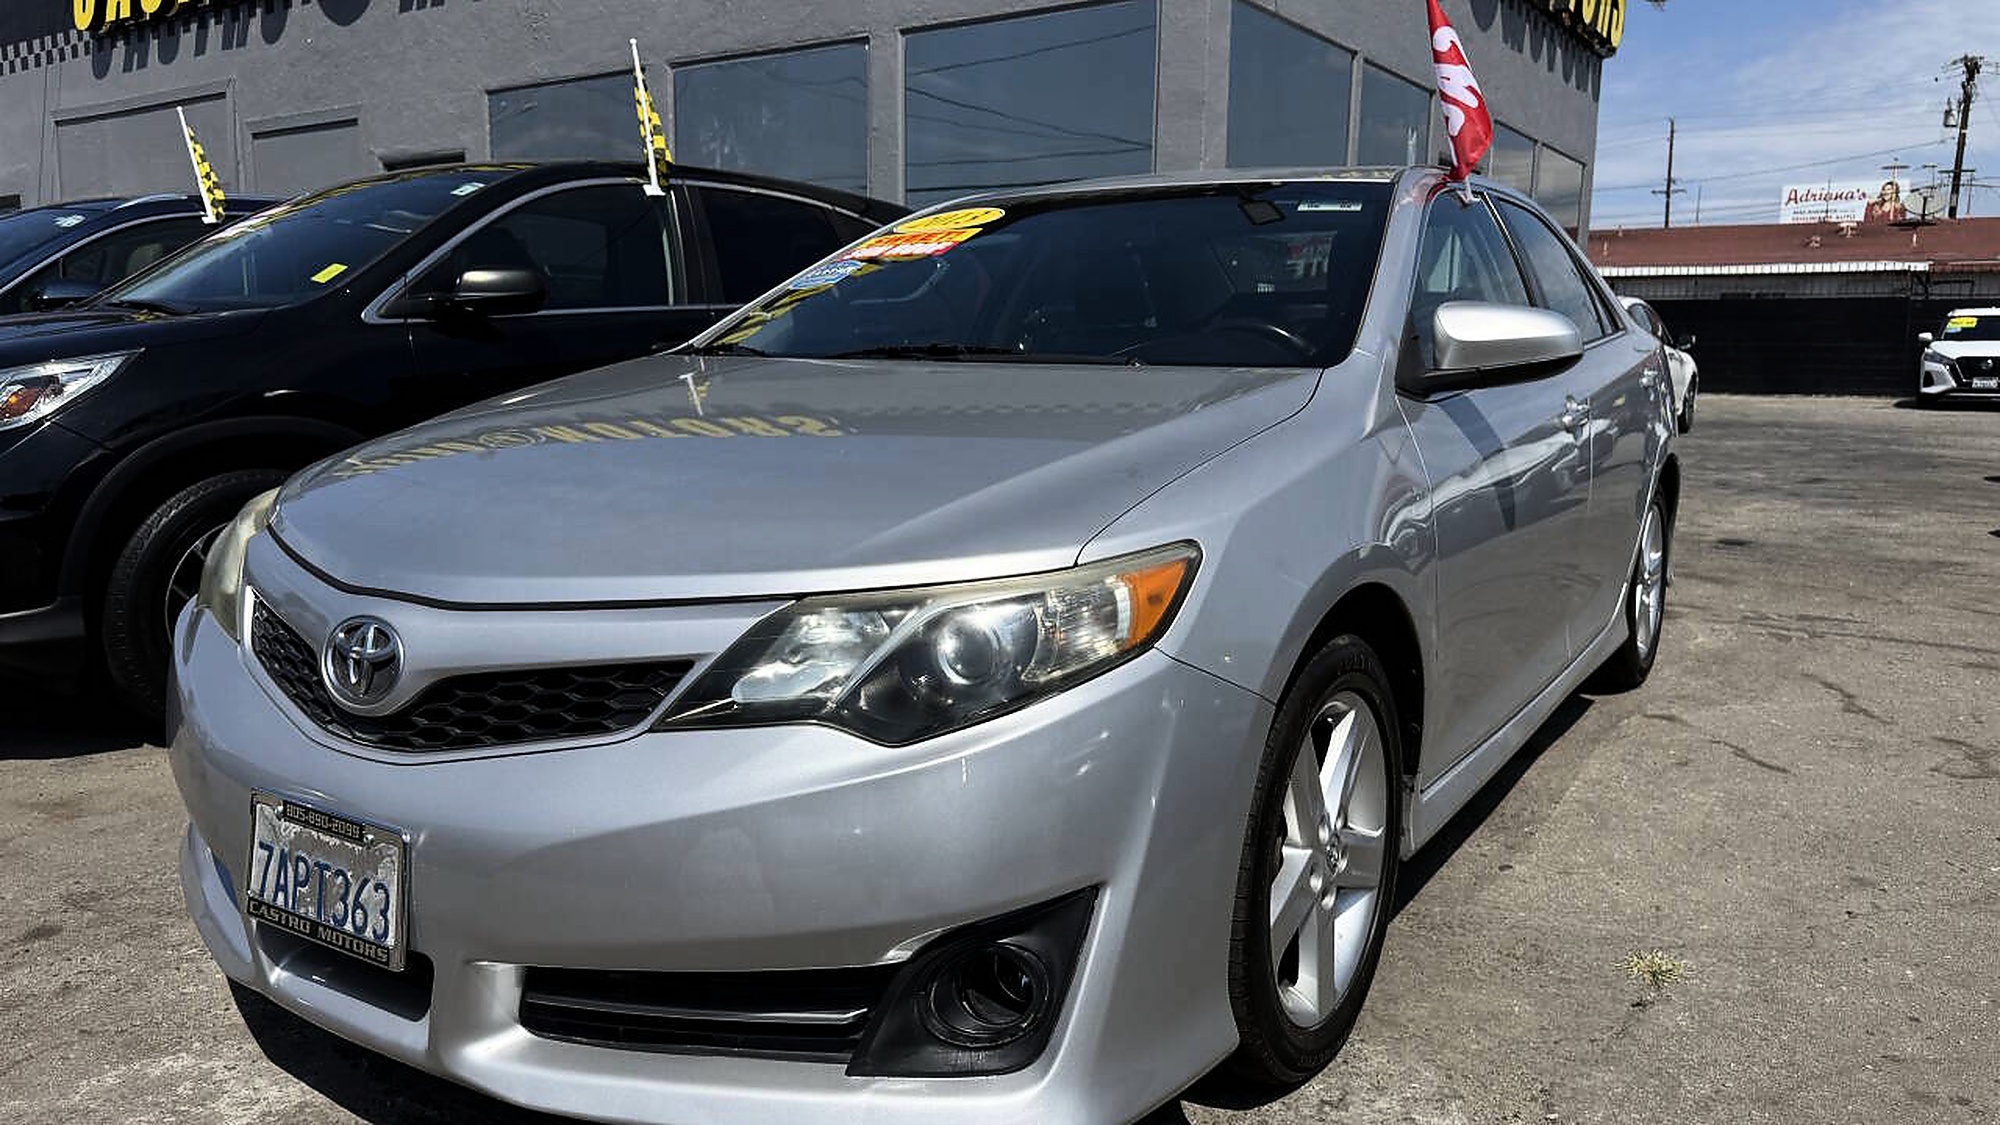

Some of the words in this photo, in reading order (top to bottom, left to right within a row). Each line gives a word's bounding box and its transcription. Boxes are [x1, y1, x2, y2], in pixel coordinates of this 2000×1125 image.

[1785, 186, 1867, 206] Adriana's
[259, 840, 390, 943] 7APT363
[249, 900, 311, 934] CASTRO
[316, 925, 388, 962] MOTORS
